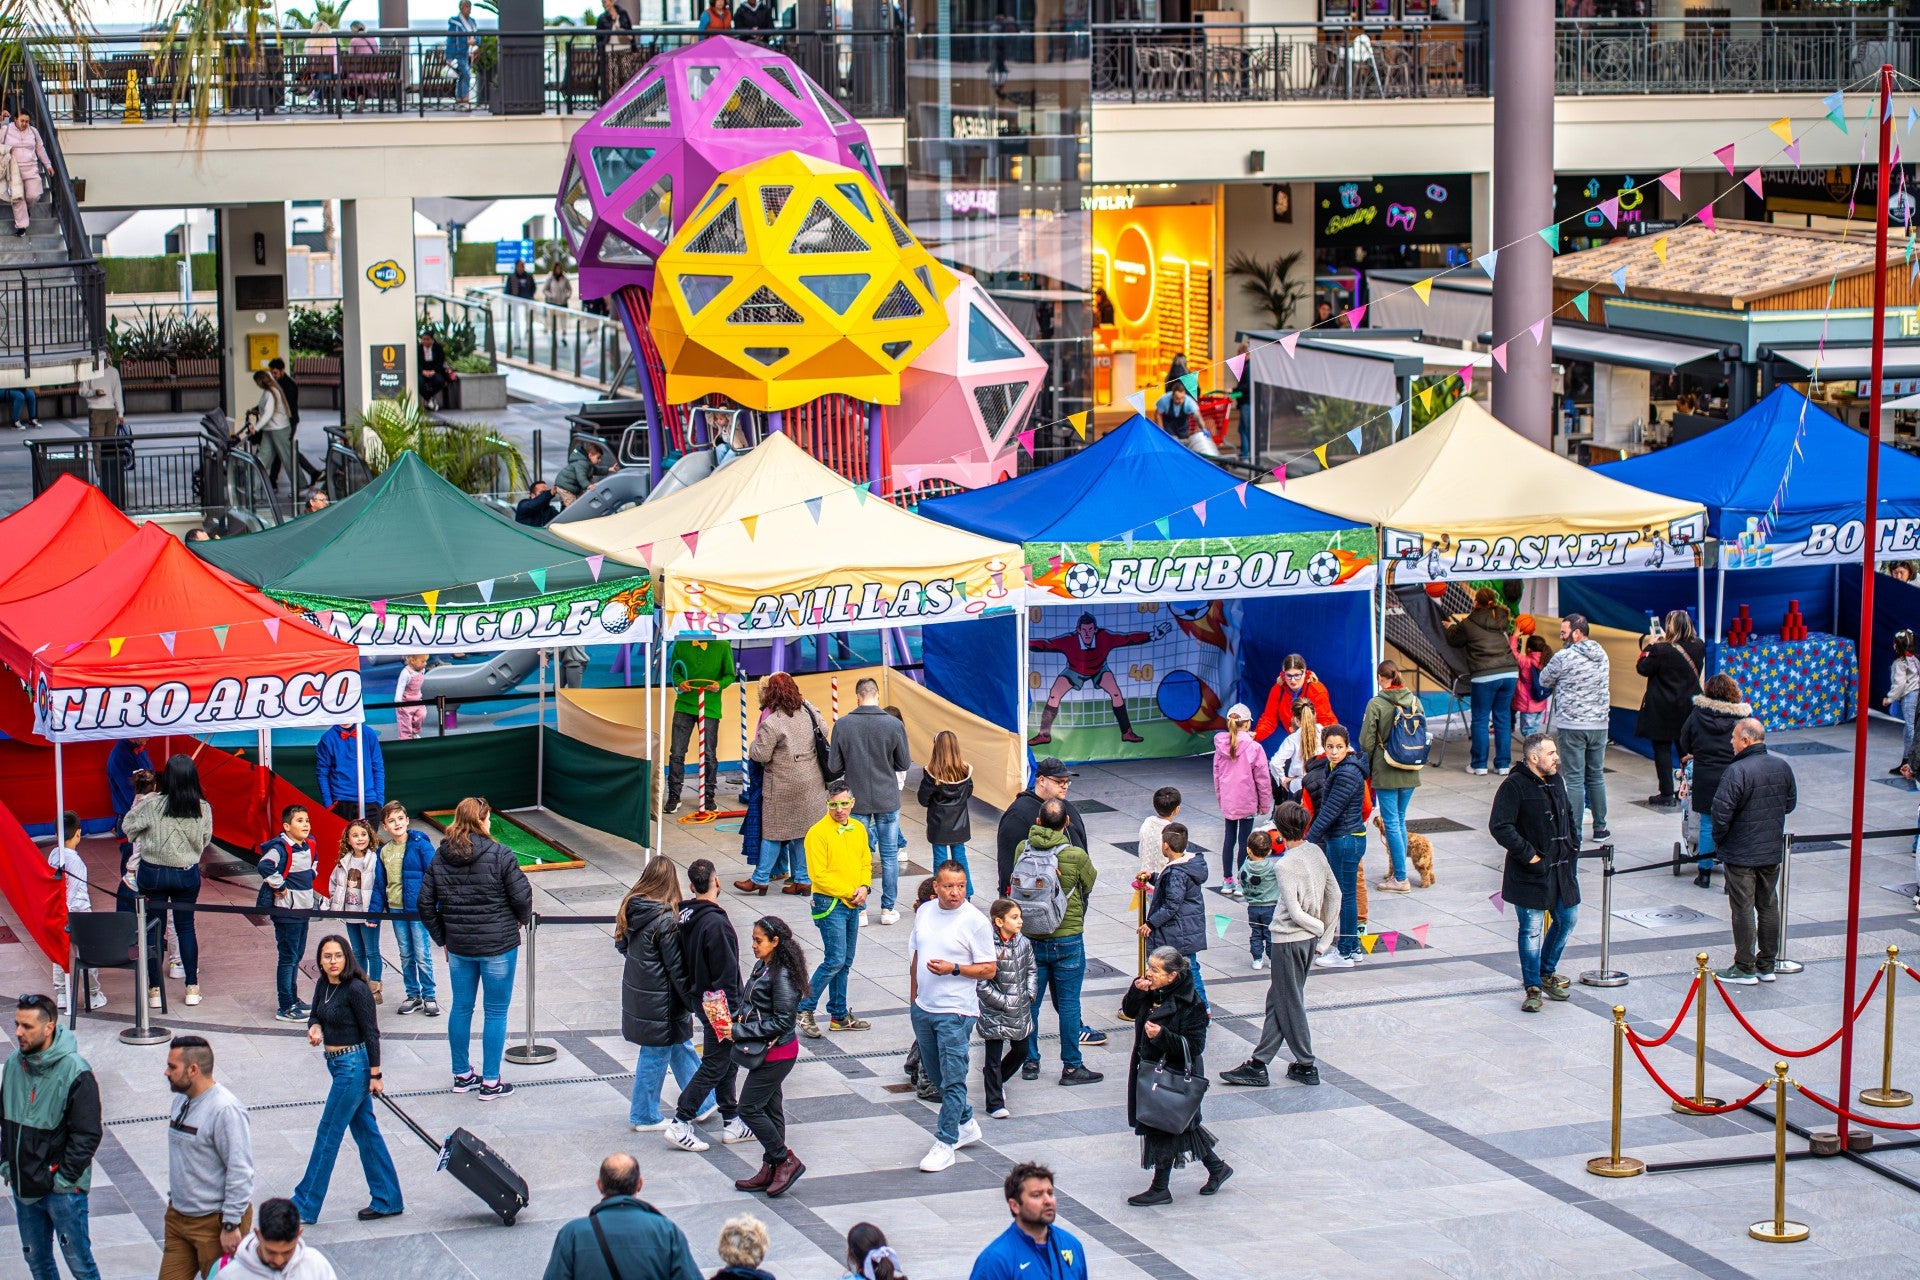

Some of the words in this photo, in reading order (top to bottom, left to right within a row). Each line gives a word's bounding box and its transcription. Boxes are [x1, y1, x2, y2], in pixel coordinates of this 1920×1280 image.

[1325, 205, 1378, 236] Bowling
[1450, 531, 1640, 573] BASKET
[1802, 517, 1920, 556] BOTE
[1101, 550, 1301, 594] FUTBOL
[329, 599, 600, 646] MINIGOLF
[738, 577, 955, 630] ANILLAS
[1129, 663, 1154, 681] 40
[50, 681, 192, 732] TIRO
[194, 669, 363, 723] ARCO
